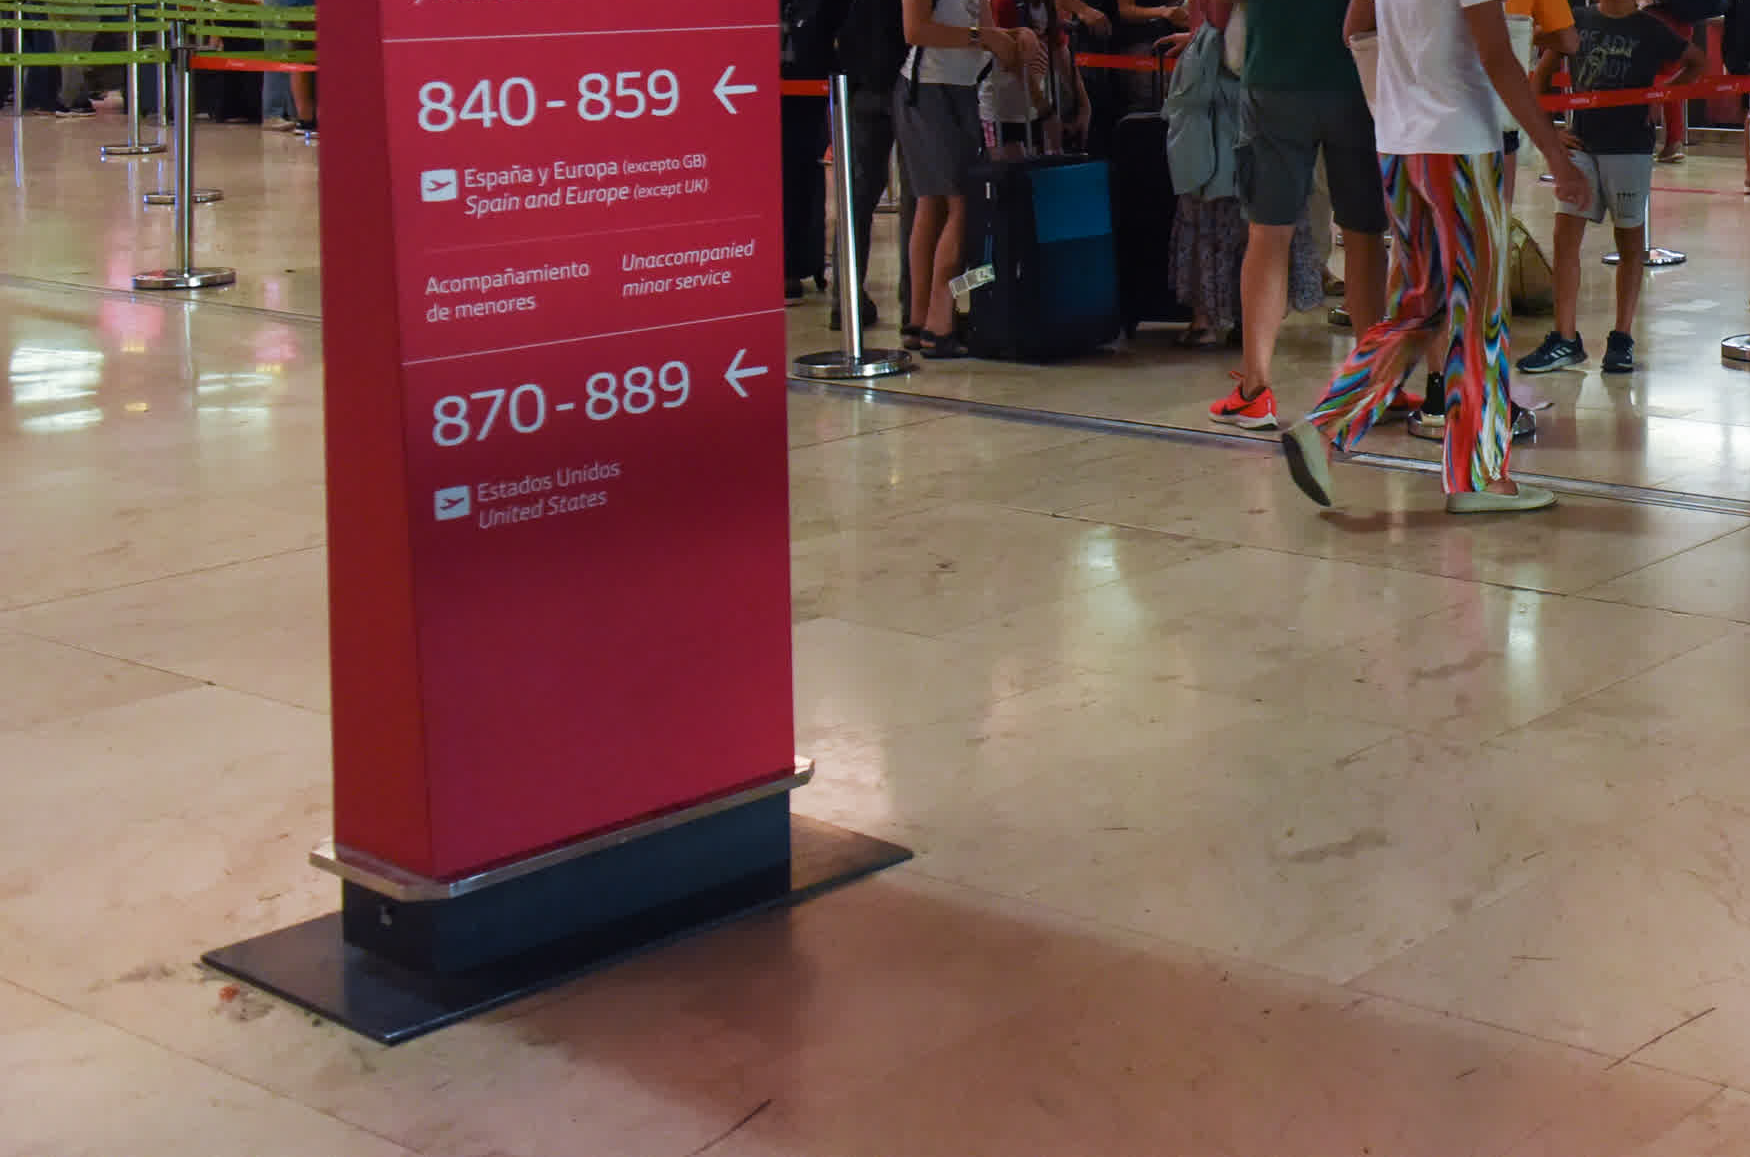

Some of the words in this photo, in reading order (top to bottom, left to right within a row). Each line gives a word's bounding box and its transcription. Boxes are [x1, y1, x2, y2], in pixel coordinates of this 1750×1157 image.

[464, 163, 534, 192] España
[538, 166, 549, 187] y
[553, 158, 618, 185] Europa
[622, 156, 680, 177] (excepto
[682, 153, 708, 173] GB)
[464, 193, 520, 219] Spain
[524, 186, 561, 210] and
[565, 181, 630, 208] Europe
[632, 180, 683, 201] (except
[684, 178, 709, 197] UK)
[620, 239, 755, 273] Unaccompanied
[424, 260, 591, 297] Acompañamiento
[622, 276, 672, 299] minor
[675, 268, 732, 293] service
[425, 300, 450, 324] de
[455, 294, 537, 321] menores
[476, 471, 553, 504] Estados
[556, 459, 622, 490] Unidos
[478, 502, 544, 530] United
[546, 488, 608, 516] States
